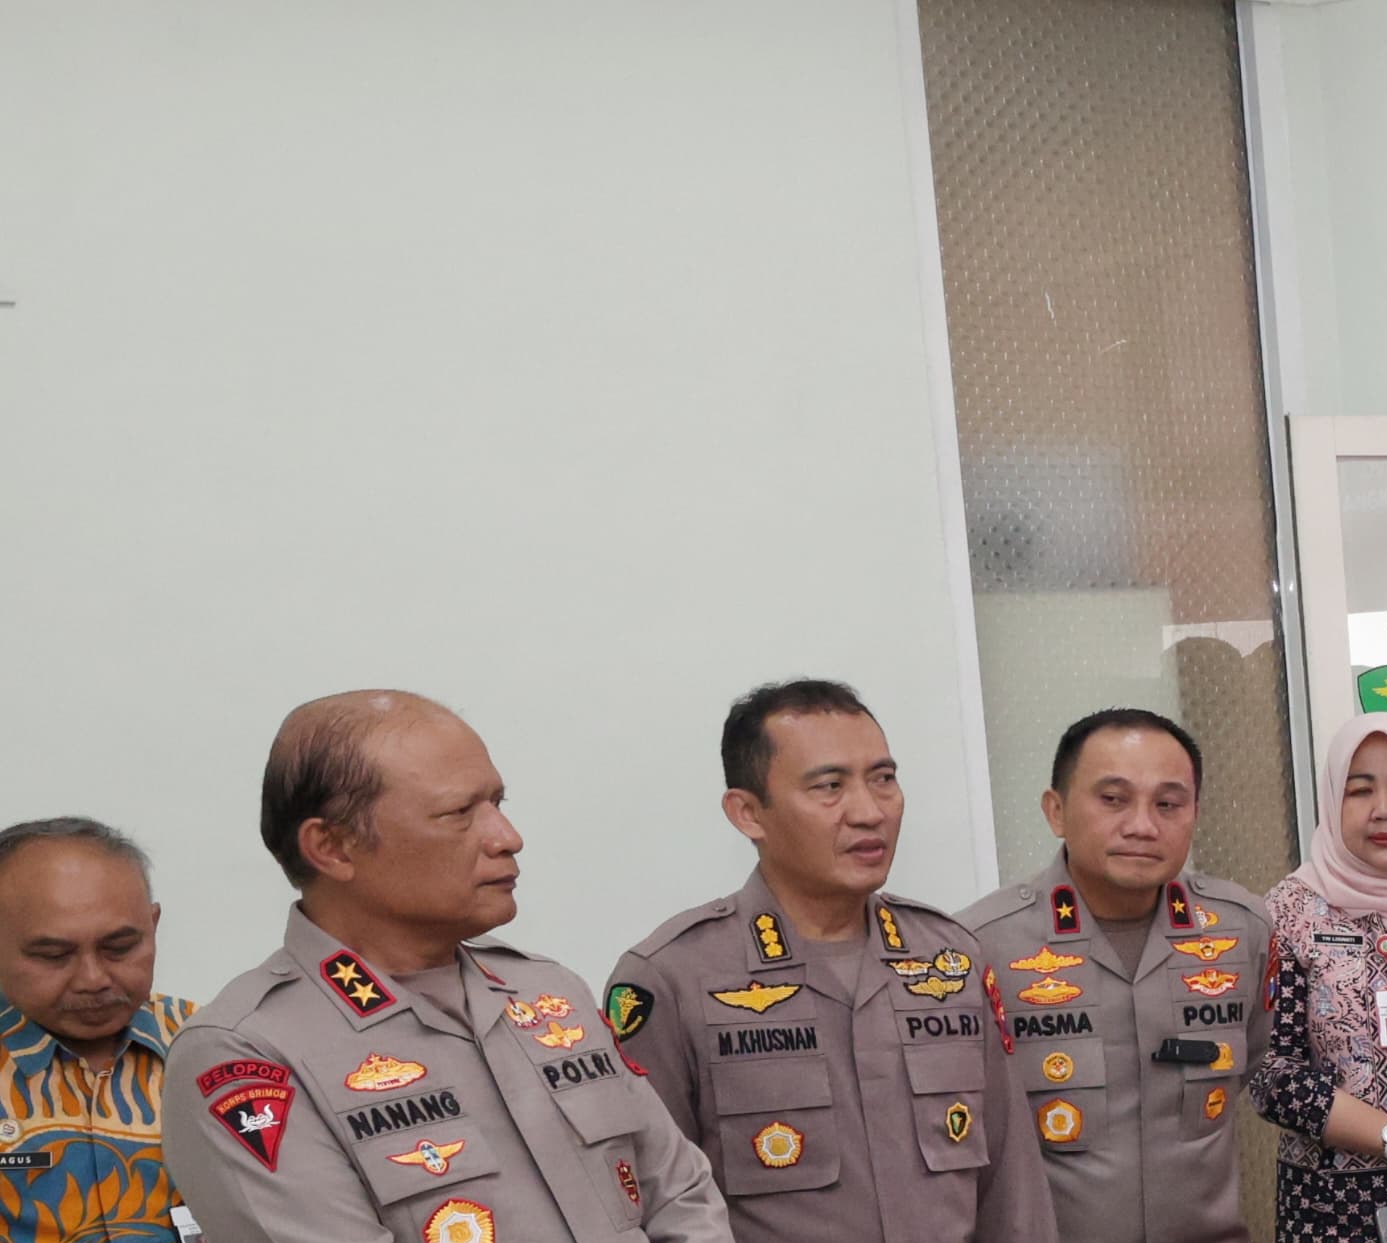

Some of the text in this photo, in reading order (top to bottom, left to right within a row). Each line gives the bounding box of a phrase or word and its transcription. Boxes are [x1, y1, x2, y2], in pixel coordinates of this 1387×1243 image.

[906, 1014, 980, 1039] POLRI
[1013, 1011, 1093, 1038] PASMA
[1183, 1002, 1244, 1027] POLRI
[718, 1026, 818, 1057] M.KHUSNAN
[202, 1063, 284, 1087] PELOPOR
[543, 1052, 617, 1090] POLRI
[346, 1091, 462, 1140] NANANG
[0, 1156, 32, 1165] AGUS
